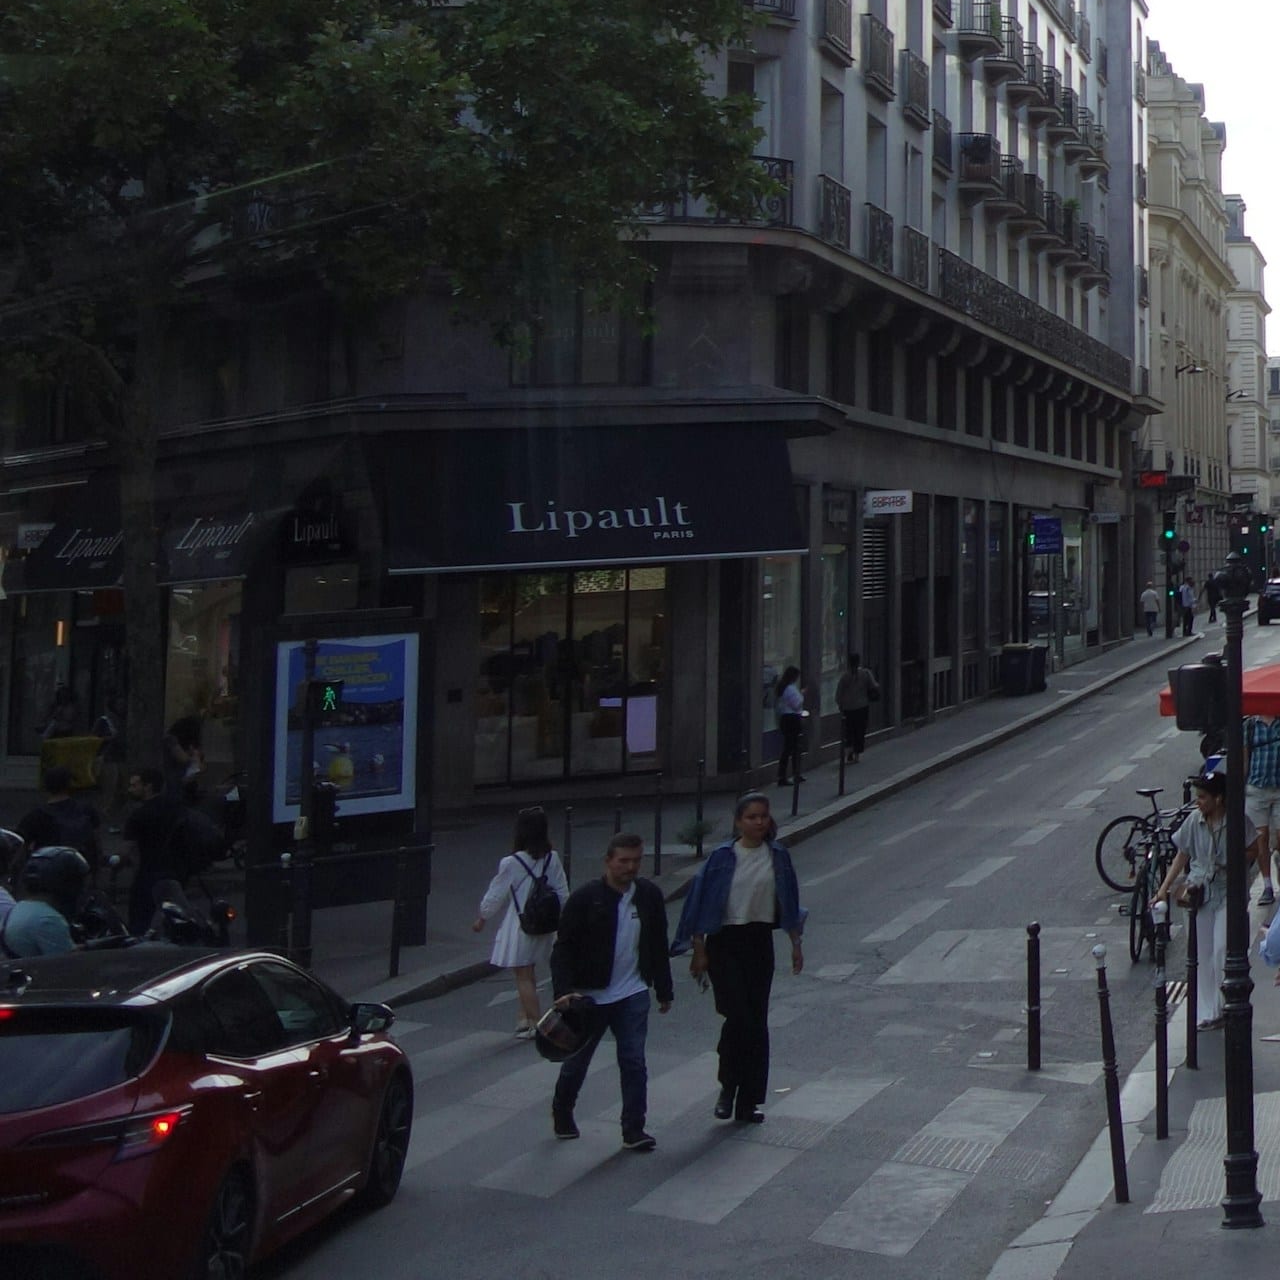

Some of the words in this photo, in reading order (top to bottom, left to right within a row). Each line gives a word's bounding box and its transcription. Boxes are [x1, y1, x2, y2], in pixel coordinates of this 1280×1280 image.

[175, 512, 255, 557] Lipault
[508, 497, 692, 538] Lipault
[653, 529, 694, 539] PARIS
